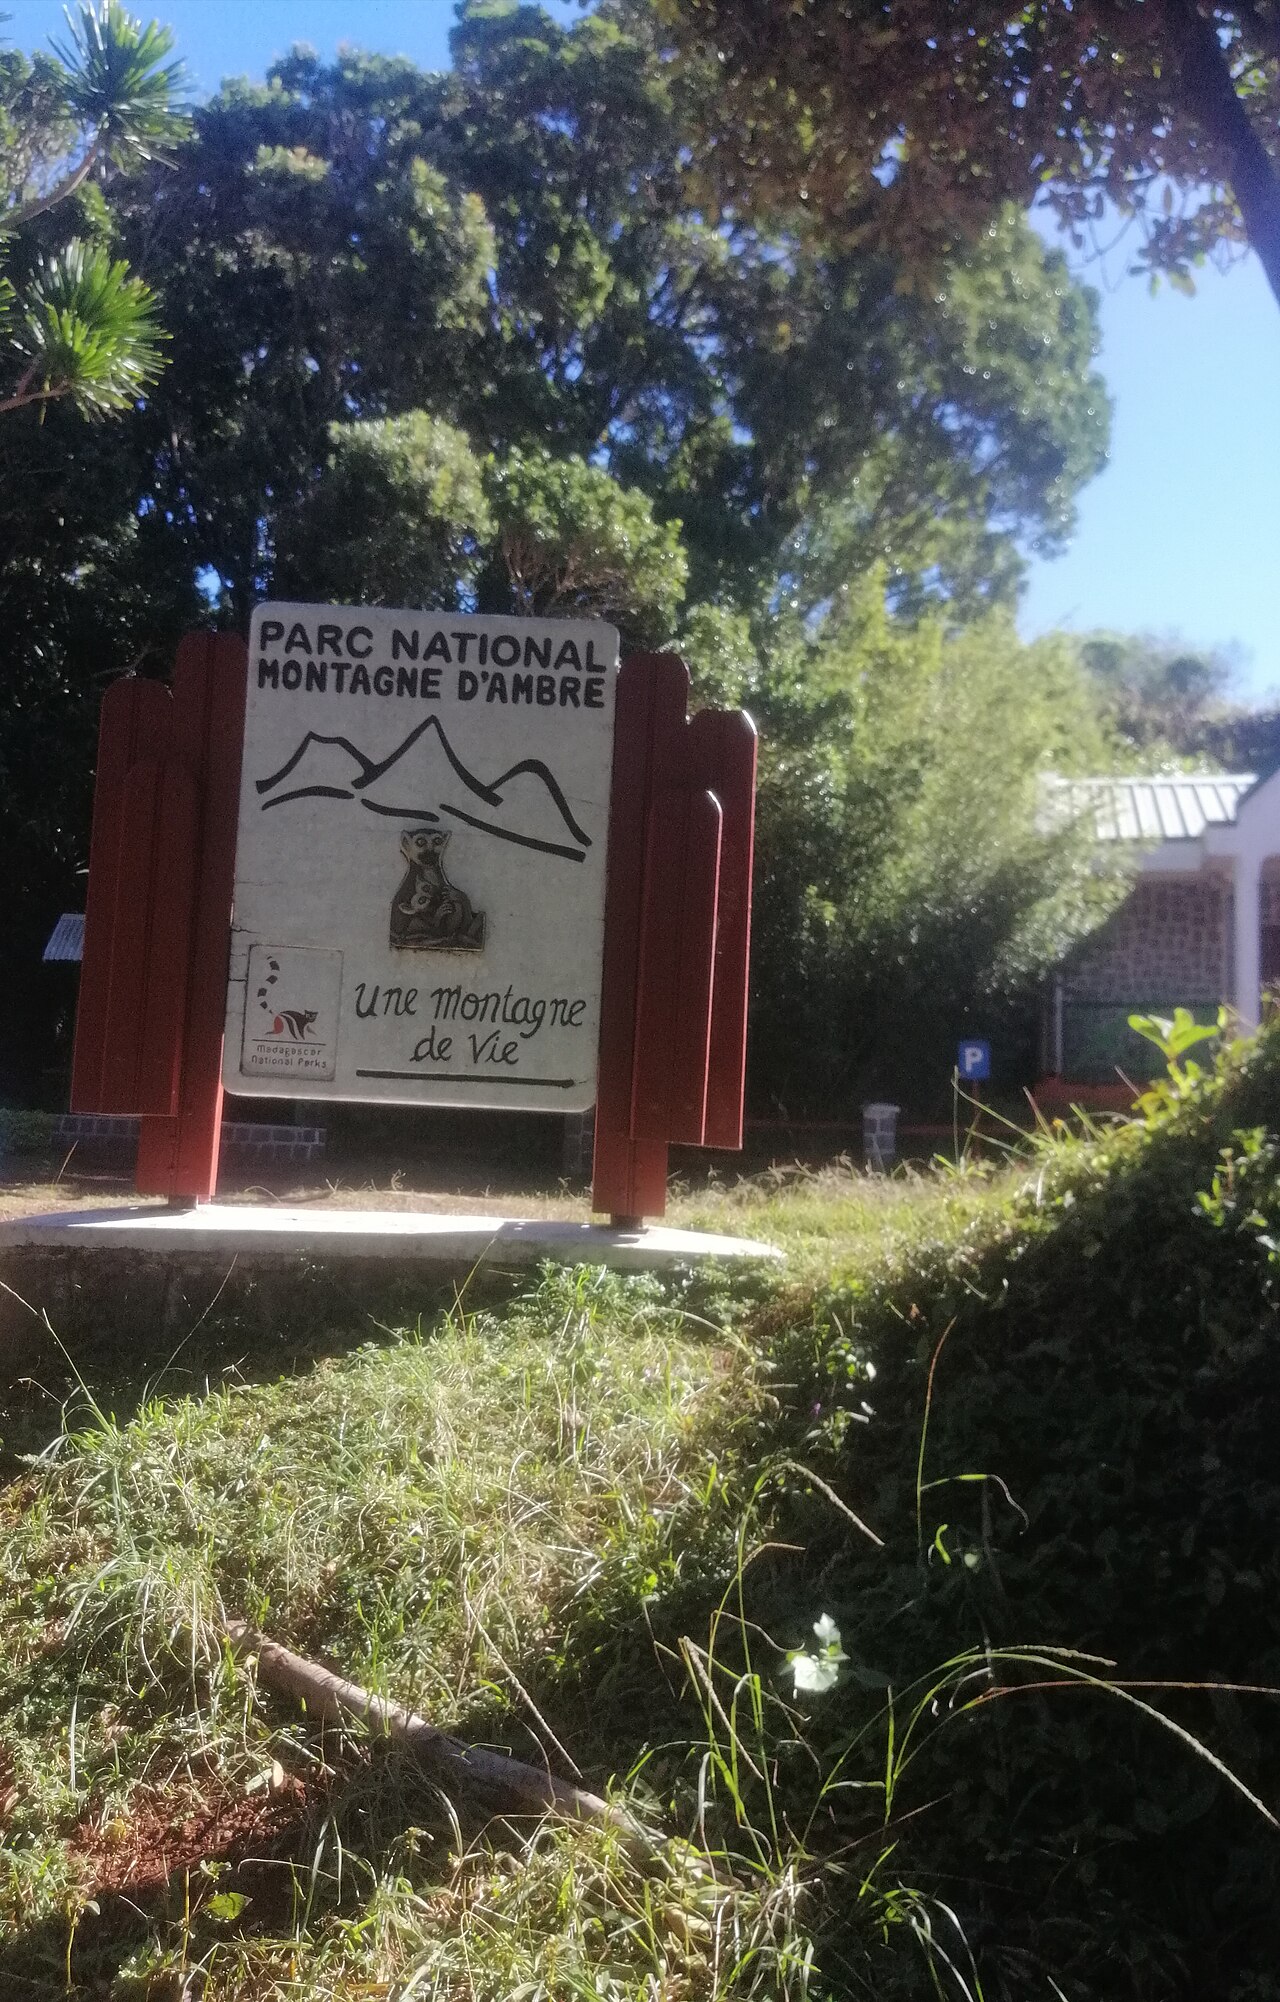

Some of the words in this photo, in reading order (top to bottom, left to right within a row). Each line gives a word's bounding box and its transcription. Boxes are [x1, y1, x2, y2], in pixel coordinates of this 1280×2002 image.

[259, 620, 373, 659] PARC
[392, 629, 608, 673] NATIONAL
[257, 658, 442, 699] MONTAGNE
[458, 671, 606, 708] D'AMBRE
[256, 1044, 322, 1057] Madagascar
[410, 1025, 452, 1062] de
[251, 1055, 293, 1066] National
[298, 1057, 327, 1069] Parks
[965, 1047, 982, 1073] P
